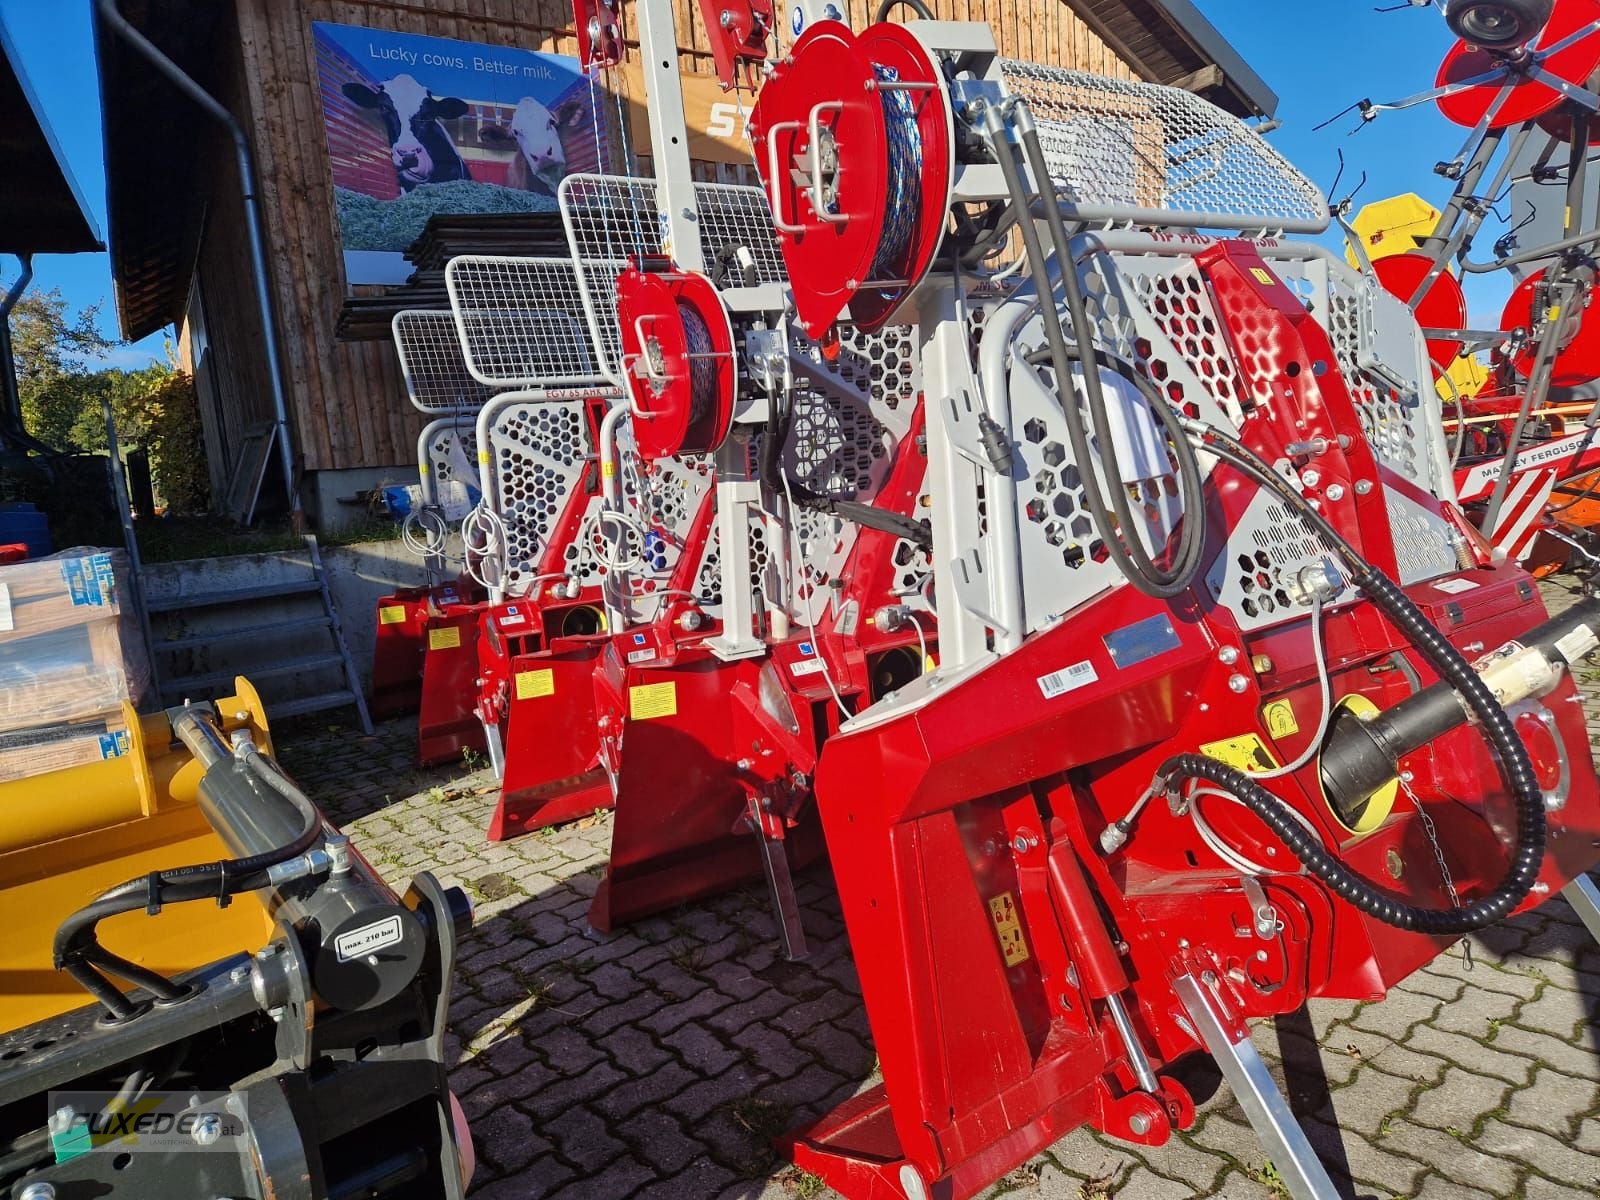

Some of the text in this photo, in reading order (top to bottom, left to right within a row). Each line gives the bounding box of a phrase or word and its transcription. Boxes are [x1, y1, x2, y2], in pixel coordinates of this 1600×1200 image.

[369, 43, 557, 81] Lucky cows. Better milk.
[546, 390, 566, 398] EGV
[1482, 436, 1594, 478] MAEY FERGUSON
[344, 928, 394, 951] max. 210 bar
